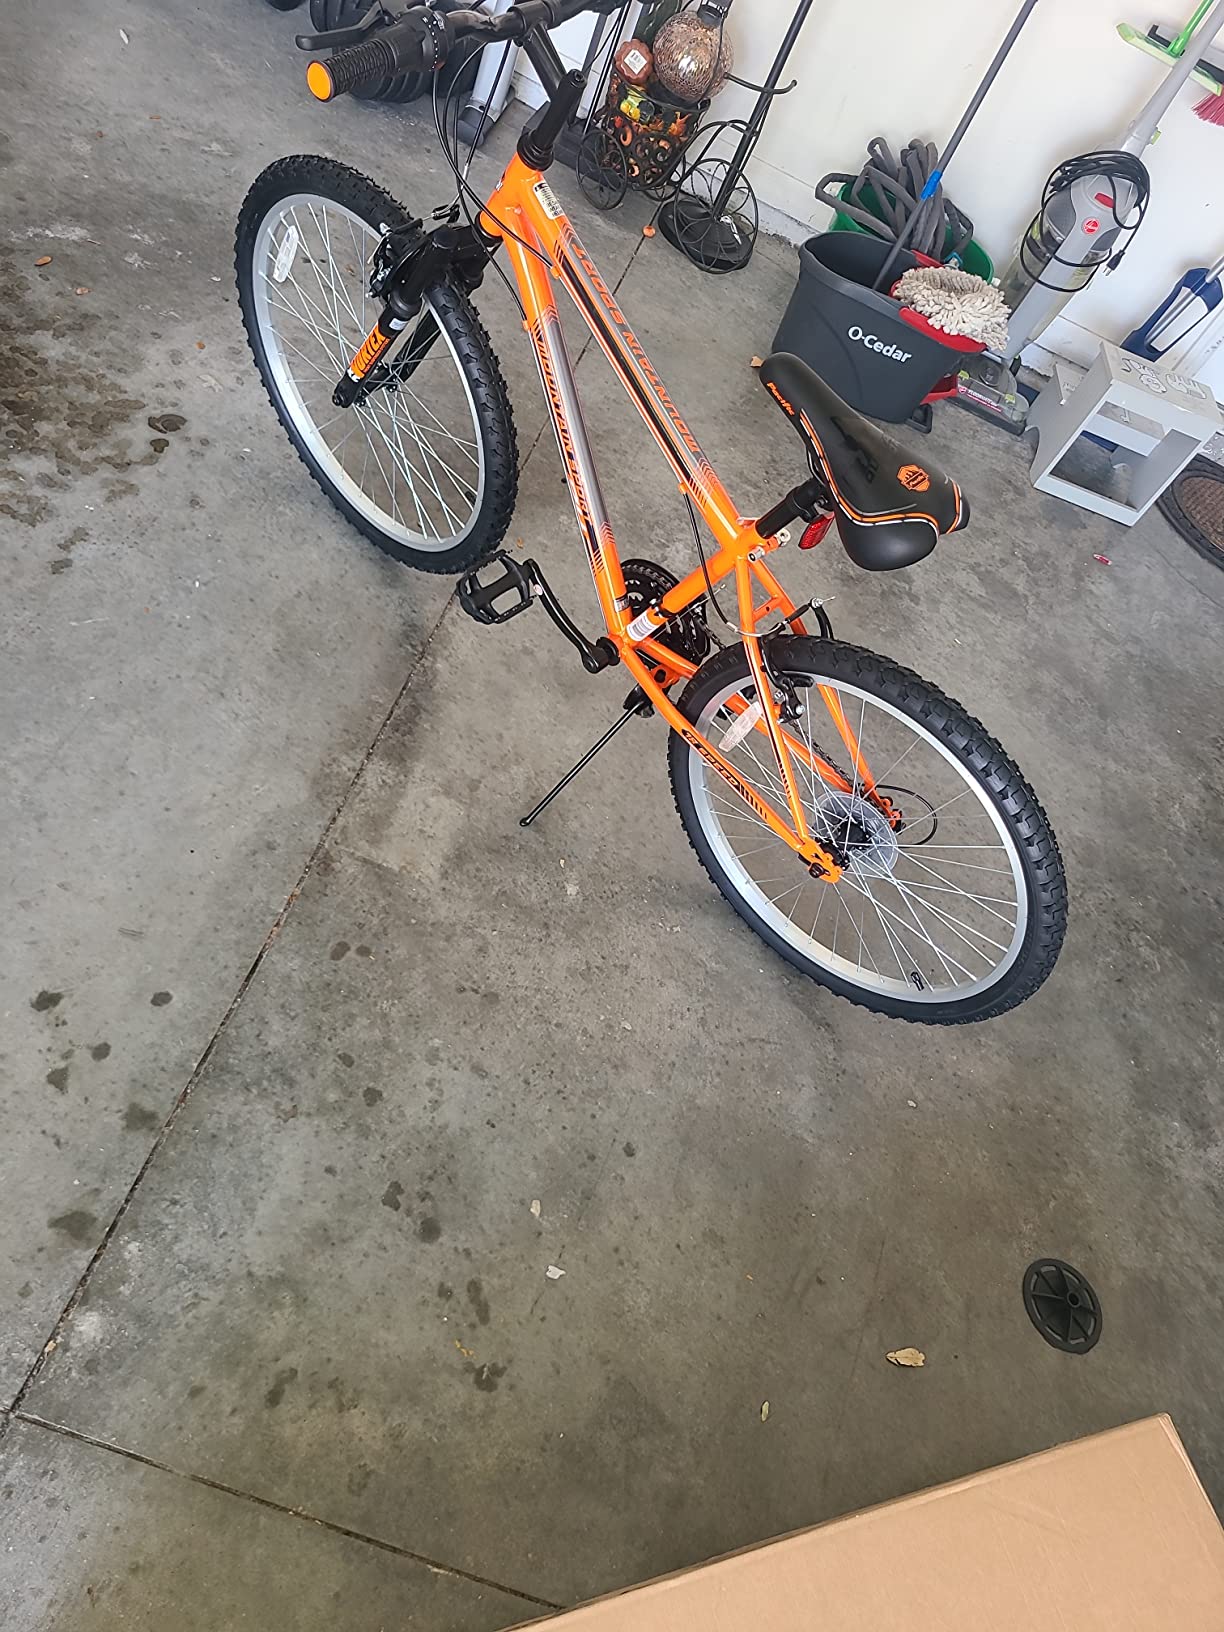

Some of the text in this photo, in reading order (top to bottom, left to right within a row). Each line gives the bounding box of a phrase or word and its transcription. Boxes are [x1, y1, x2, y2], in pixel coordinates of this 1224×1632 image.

[572, 243, 701, 453] MOUNTAIN SPORT
[848, 326, 912, 362] O-Cedar
[767, 382, 795, 416] Pacific
[536, 339, 592, 526] MOUNTAIN SPORT
[700, 747, 738, 786] SPEED
